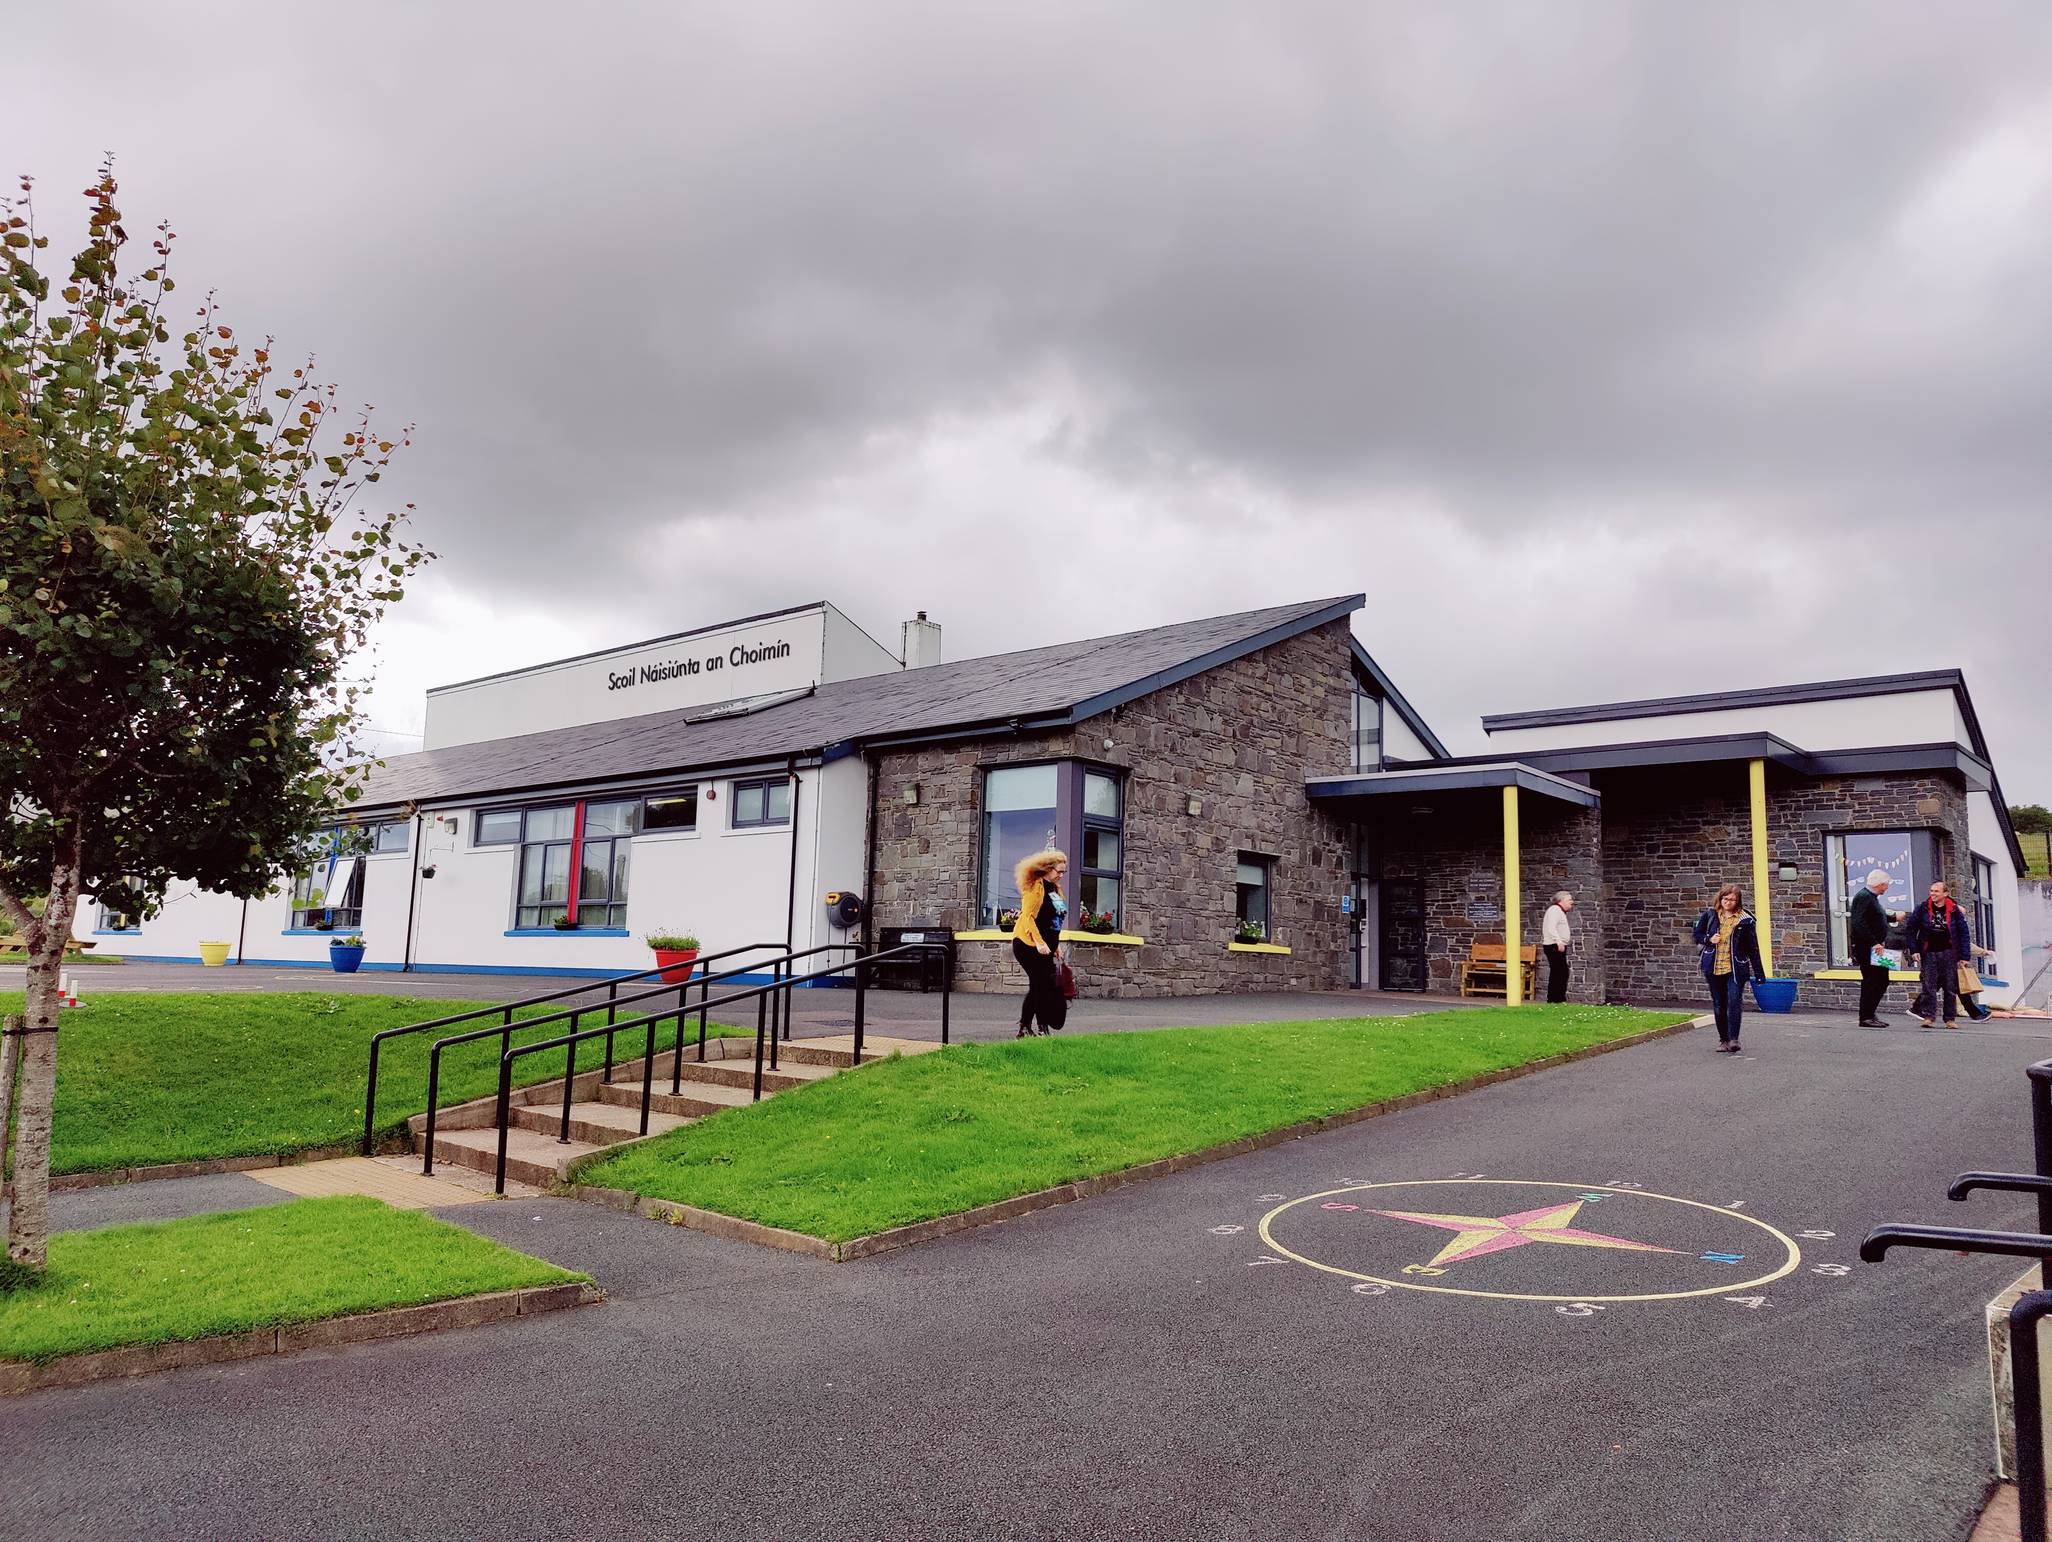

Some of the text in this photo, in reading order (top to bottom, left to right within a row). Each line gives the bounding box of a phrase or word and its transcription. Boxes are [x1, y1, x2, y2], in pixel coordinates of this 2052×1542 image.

[608, 639, 790, 690] Scoil Náisiúnta an Choimín
[1795, 1230, 1836, 1240] 2
[1247, 1255, 1289, 1266] 7
[1811, 1263, 1852, 1276] 3
[1351, 1283, 1392, 1295] 6
[1555, 1302, 1605, 1316] 5
[1724, 1296, 1774, 1309] 4
